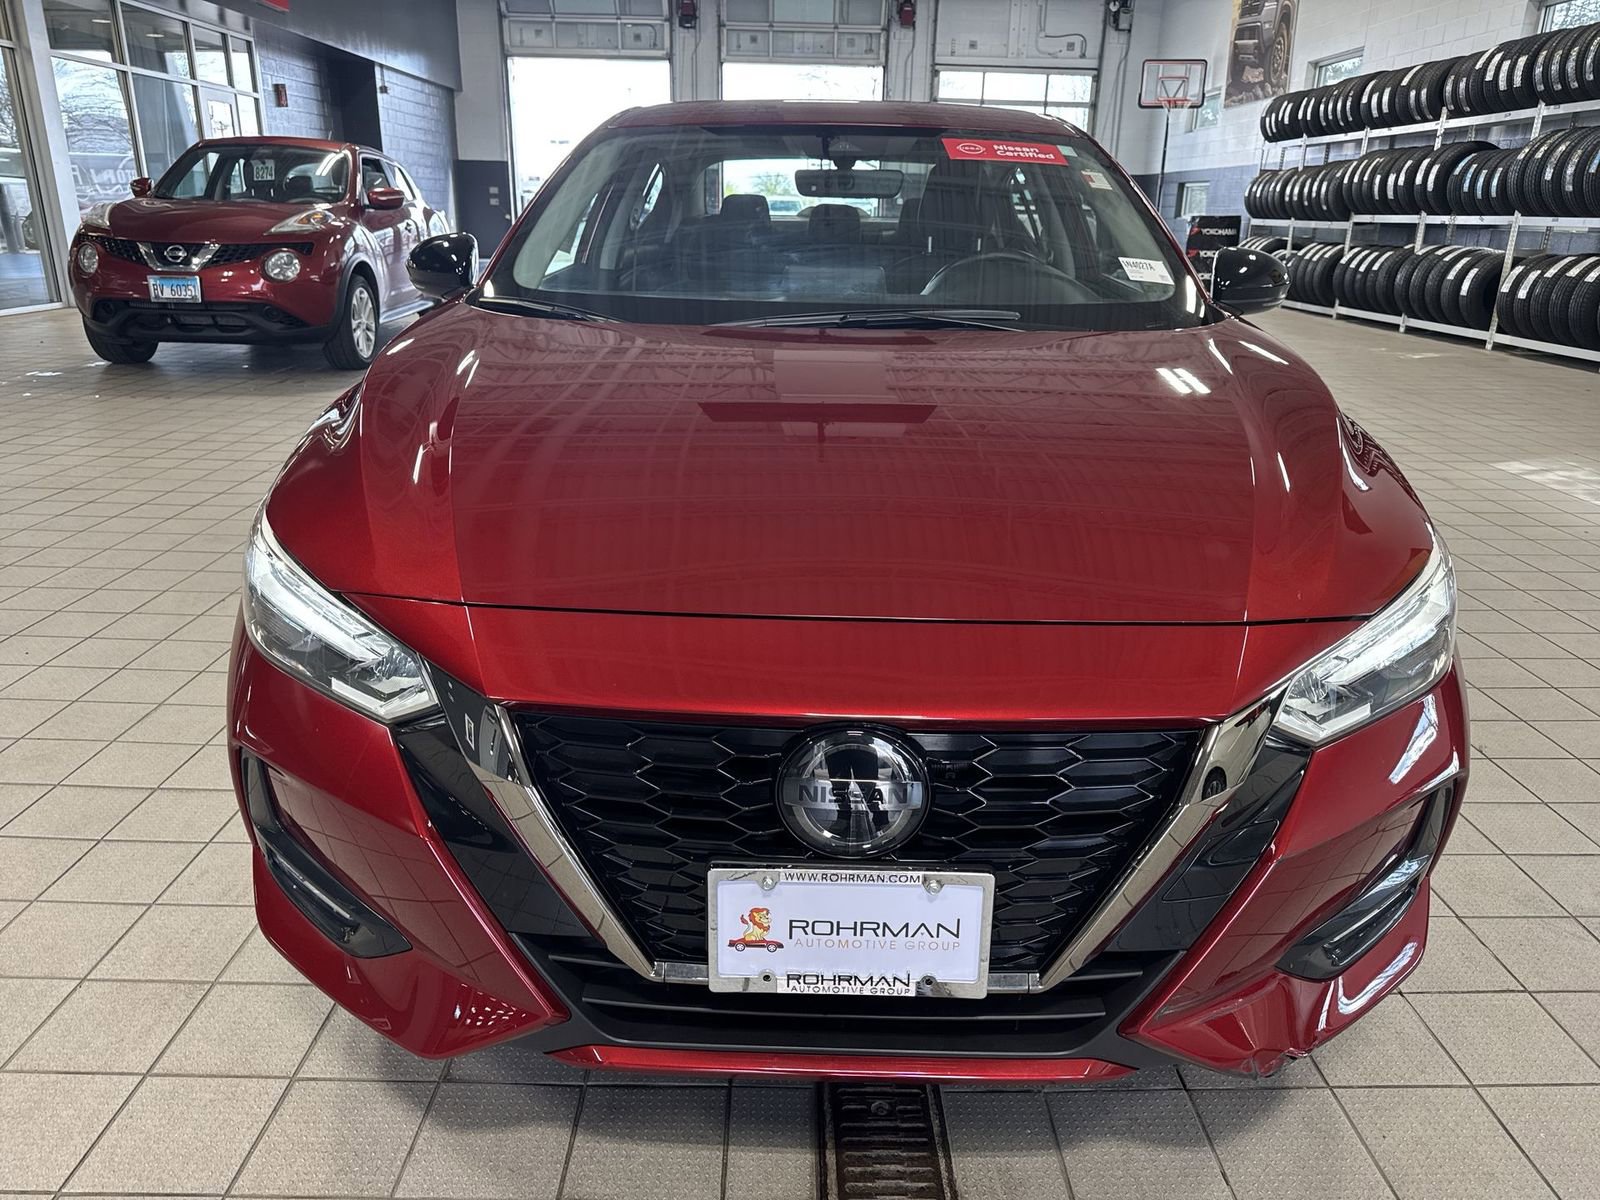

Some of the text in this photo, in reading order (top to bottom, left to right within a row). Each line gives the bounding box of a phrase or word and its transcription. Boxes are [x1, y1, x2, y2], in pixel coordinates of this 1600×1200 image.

[993, 144, 1039, 153] Nissan
[996, 150, 1055, 159] Certified
[255, 166, 273, 180] 8274
[784, 873, 920, 883] WWW.ROHRMAN.COM
[788, 918, 960, 939] ROHRMAN
[794, 939, 960, 951] AUTOMOTIVE GROUP
[786, 973, 910, 988] ROHRMAN
[791, 986, 911, 995] AUTOMOTIVE GROUP
